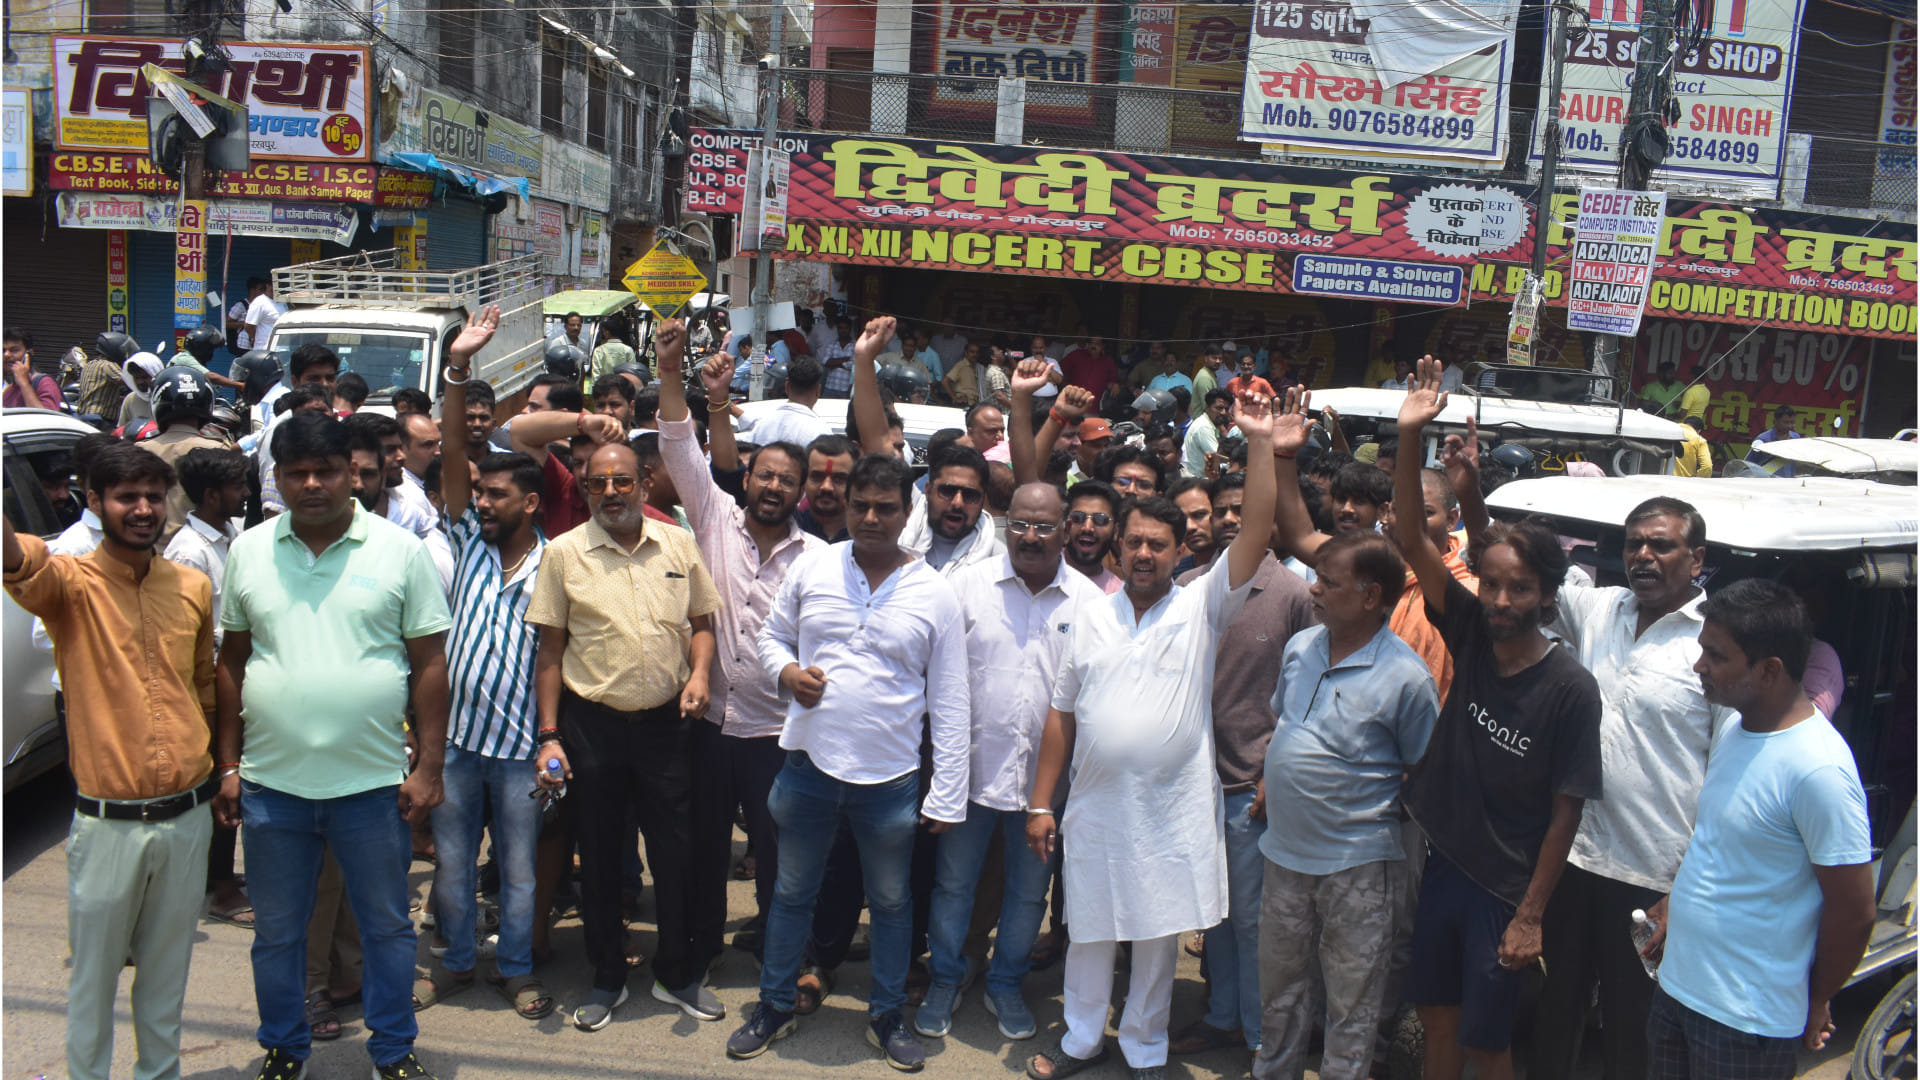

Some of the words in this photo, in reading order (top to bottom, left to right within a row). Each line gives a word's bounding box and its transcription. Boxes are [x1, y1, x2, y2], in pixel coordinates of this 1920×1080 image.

[1260, 2, 1303, 29] 125
[1707, 42, 1777, 74] SHOP
[1259, 61, 1383, 105] सौरभ
[1394, 74, 1487, 116] सिंह
[1262, 103, 1318, 129] Mob.
[1328, 108, 1474, 140] 9076584899
[1690, 103, 1773, 137] SINGH
[343, 133, 360, 152] 50
[54, 155, 128, 174] C.B.S.E.
[689, 152, 736, 168] CBSE
[69, 175, 94, 188] Text
[99, 177, 134, 191] Book,
[323, 167, 373, 184] I.S.C.
[688, 171, 718, 187] U.P.
[286, 185, 309, 197] Bank
[311, 186, 342, 200] Sample
[345, 187, 373, 200] Paper
[688, 190, 726, 206] B.Ed
[823, 139, 1130, 216] द्विवेदी
[1145, 175, 1394, 236] ब्रदर्स
[1582, 193, 1634, 216] CEDET
[935, 210, 984, 221] चौक
[1008, 215, 1106, 231] गोरखपुर
[1446, 212, 1466, 228] के
[1579, 216, 1618, 233] COMPUTER
[1619, 219, 1657, 235] INSTITUTE
[1169, 224, 1216, 241] Mob:
[1222, 228, 1333, 248] 7565033452
[860, 228, 901, 258] XII
[911, 230, 1106, 277] NCERT,
[1121, 244, 1276, 286] CBSE
[1576, 243, 1617, 262] ADCA
[1619, 247, 1649, 265] DCA
[1303, 258, 1370, 278] Sample
[1393, 266, 1455, 283] Solved
[1574, 261, 1614, 282] TALLY
[1615, 267, 1645, 285] DFA
[1301, 274, 1365, 292] Papers
[1367, 280, 1453, 299] Available
[1572, 282, 1610, 302] ADFA
[1611, 287, 1642, 305] ADIT
[1789, 274, 1819, 288] Mob:
[1823, 278, 1894, 296] 7565033452
[1592, 303, 1612, 315] Java
[1650, 280, 1844, 327] COMPETITION
[1849, 299, 1917, 334] BOO
